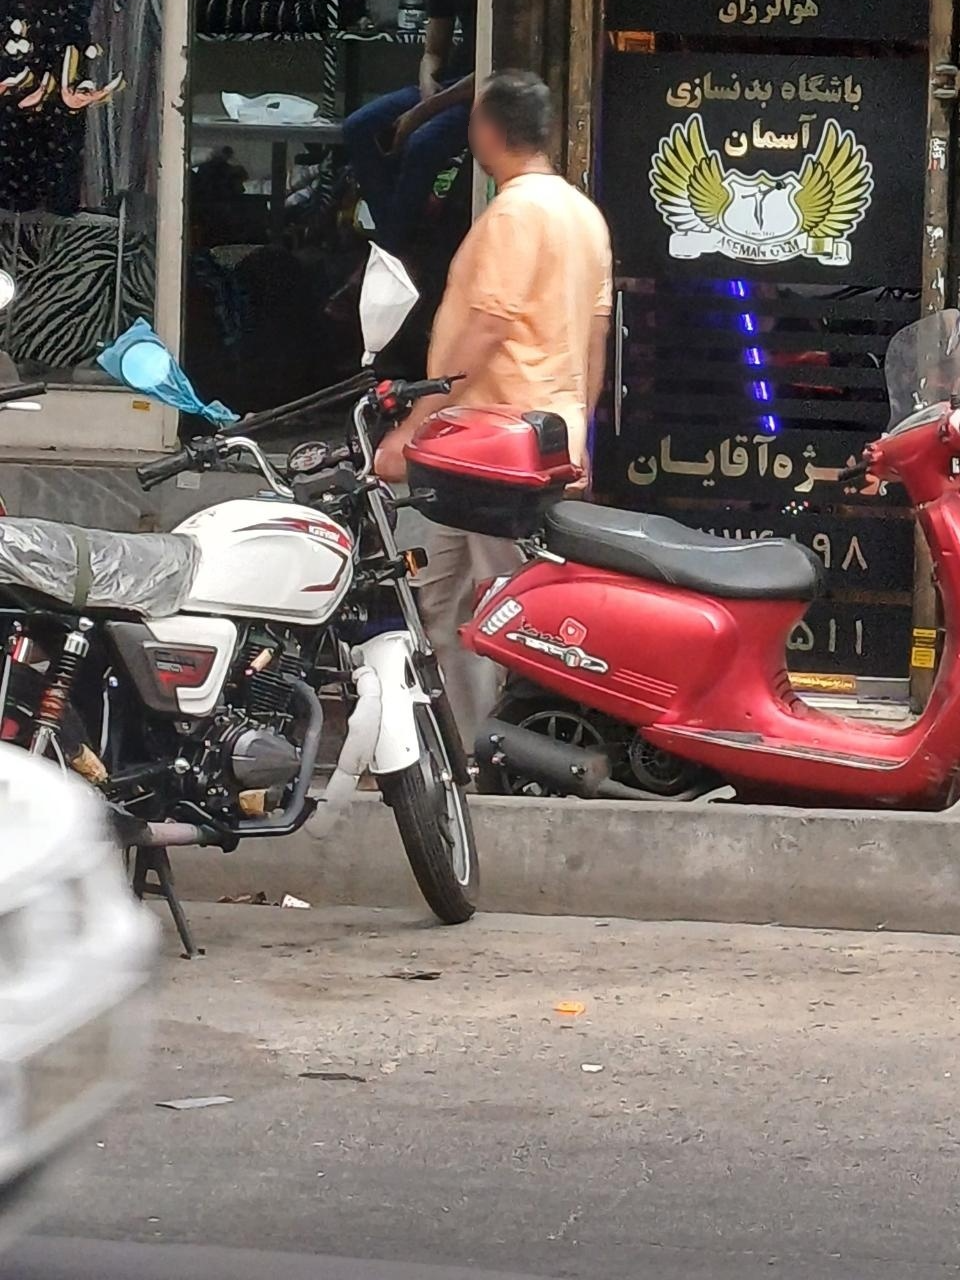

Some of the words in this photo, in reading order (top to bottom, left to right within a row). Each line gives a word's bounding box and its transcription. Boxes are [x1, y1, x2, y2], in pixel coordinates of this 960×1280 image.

[666, 72, 774, 109] بدنسازی
[781, 73, 862, 111] باشگاه
[724, 113, 818, 157] آسمان
[627, 434, 777, 486] آقایان
